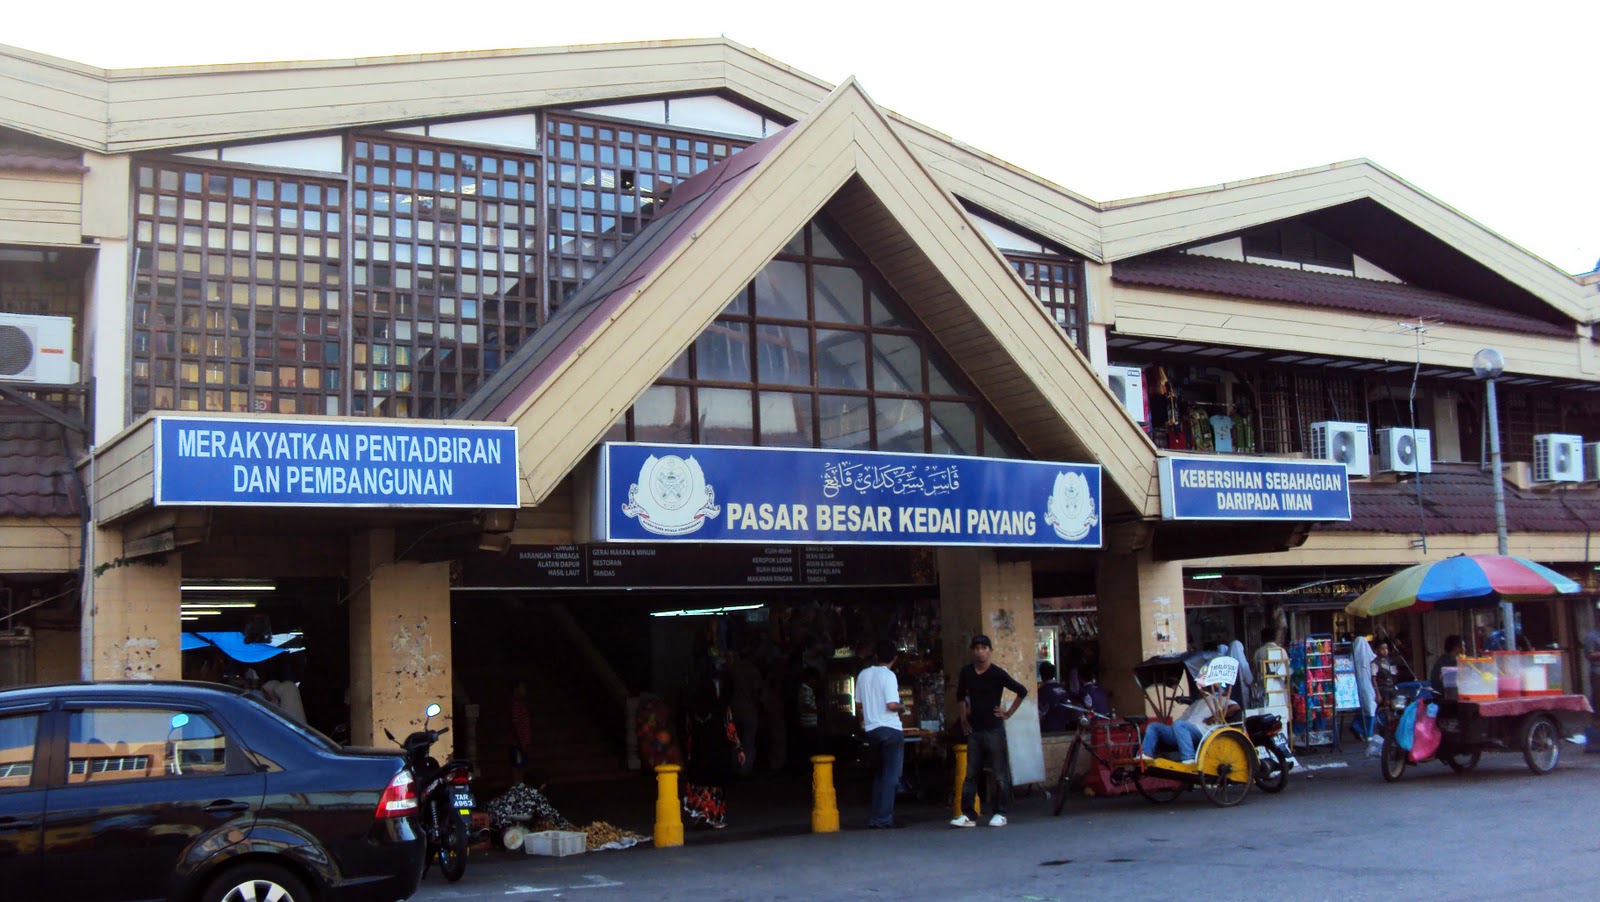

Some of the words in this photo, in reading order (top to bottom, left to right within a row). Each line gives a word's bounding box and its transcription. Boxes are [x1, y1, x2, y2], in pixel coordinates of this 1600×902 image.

[178, 429, 348, 461] MERAKYATKAN
[355, 434, 501, 464] PENTADBIRAN
[233, 465, 280, 493] DAN
[286, 467, 453, 496] PEMBANGUNAN
[1180, 469, 1262, 489] KEBERSIHAN
[1265, 472, 1342, 492] SEBAHAGIAN
[1216, 491, 1280, 511] DARIPADA
[1281, 494, 1313, 511] IMAN
[726, 502, 809, 531] PASAR
[816, 504, 893, 532] BESAR
[898, 506, 961, 534] KEDAI
[967, 508, 1036, 536] PAYANG
[519, 552, 551, 560] BARANGAN
[592, 559, 622, 567] RESTORAN
